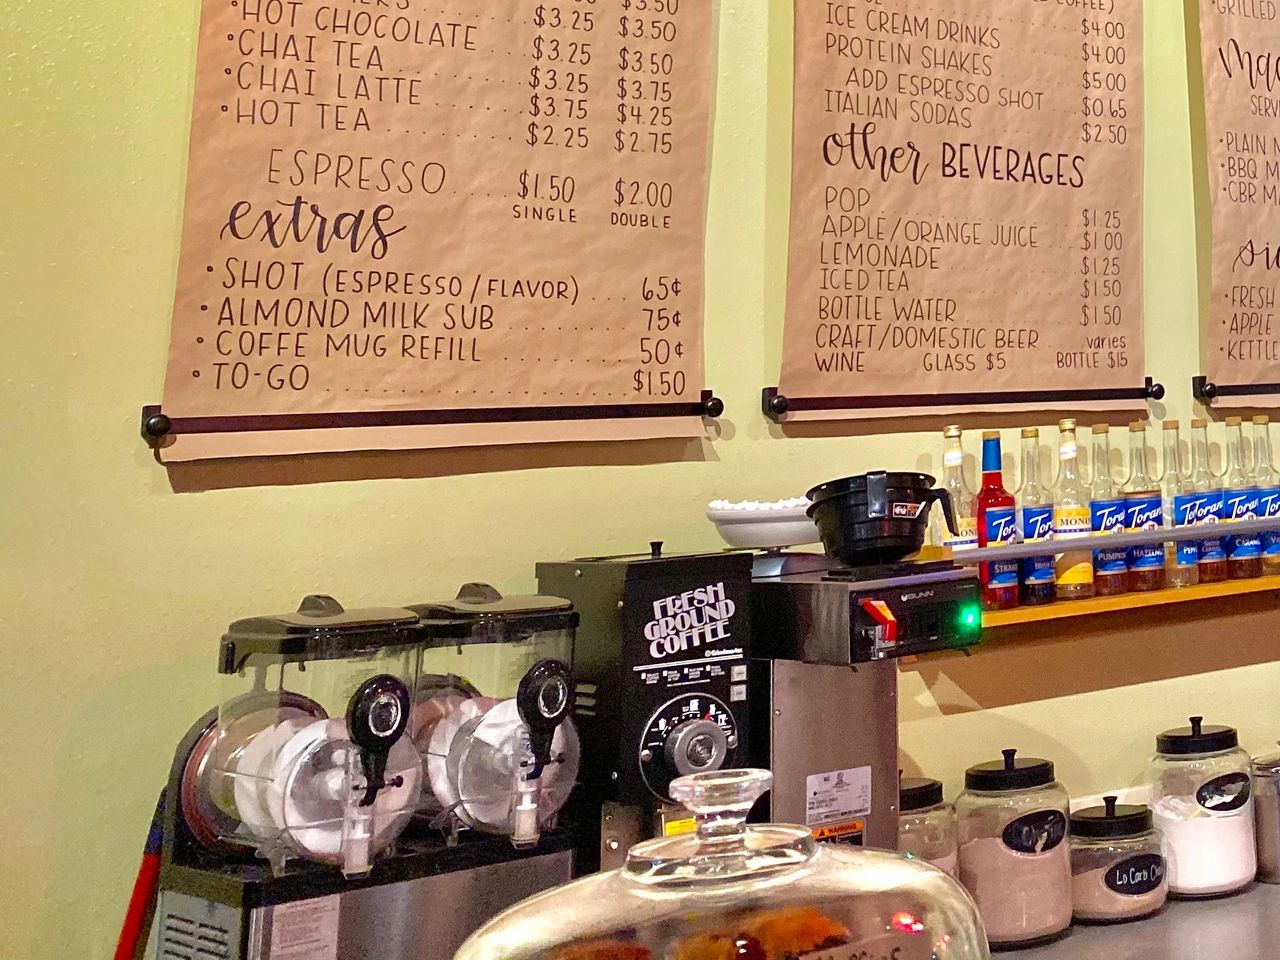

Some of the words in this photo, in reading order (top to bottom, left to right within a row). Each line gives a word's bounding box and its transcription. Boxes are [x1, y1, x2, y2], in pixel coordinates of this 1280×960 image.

[314, 6, 478, 51] CHOCOLATE
[533, 37, 591, 65] $3.25
[619, 49, 673, 75] $3.50
[826, 2, 855, 29] ICE
[866, 9, 929, 38] CREAM
[937, 20, 1000, 49] DRINKS
[239, 30, 317, 62] CHAI
[334, 40, 384, 71] TEA
[826, 33, 911, 64] PROTEIN
[922, 46, 992, 76] SHAKES
[237, 64, 317, 97] CHAI
[337, 73, 422, 105] LATTE
[529, 95, 587, 120] $3.75
[616, 102, 672, 126] $4.25
[846, 67, 888, 90] ADD
[898, 74, 989, 104] ESPRESSO
[999, 88, 1044, 110] SHOT
[824, 89, 898, 120] ITALIAN
[911, 100, 972, 128] SODAS
[236, 100, 301, 128] HOT
[319, 104, 370, 132] TEA
[526, 122, 588, 149] $2.25
[614, 129, 672, 154] $2.75
[1226, 131, 1265, 155] PLAIN
[822, 121, 929, 185] other
[942, 142, 1085, 188] BEVERAGES
[1228, 157, 1256, 180] BBQ
[267, 148, 446, 194] ESPRESSO
[517, 170, 574, 203] $1.50
[614, 177, 672, 209] $2.00
[513, 204, 577, 223] SINGLE
[610, 213, 671, 229] DOUBLE
[825, 186, 870, 212] POP
[220, 194, 406, 260] extras
[821, 242, 940, 269] LEMONADE
[222, 257, 304, 291] SHOT
[821, 269, 869, 290] ICED
[878, 271, 909, 290] TEA
[218, 297, 349, 327] ALMOND
[363, 302, 428, 328] MILK
[444, 304, 493, 330] SUB
[819, 296, 882, 321] BOTTLE
[891, 298, 956, 321] WATER
[1232, 286, 1274, 310] FRESH
[216, 331, 306, 356] COFFE
[325, 334, 386, 358] MUG
[402, 335, 480, 362] REFILL
[815, 352, 864, 372] WINE
[923, 353, 976, 372] GLASS
[986, 354, 1006, 371] $5
[1057, 351, 1099, 369] BOTTLE
[1108, 352, 1128, 368] $15
[1227, 340, 1278, 361] KETTLE
[213, 363, 309, 391] TO-GO
[633, 371, 686, 397] $1.50
[653, 582, 725, 619] FRESH
[644, 599, 735, 640] GROUND
[649, 619, 731, 658] COFFEE
